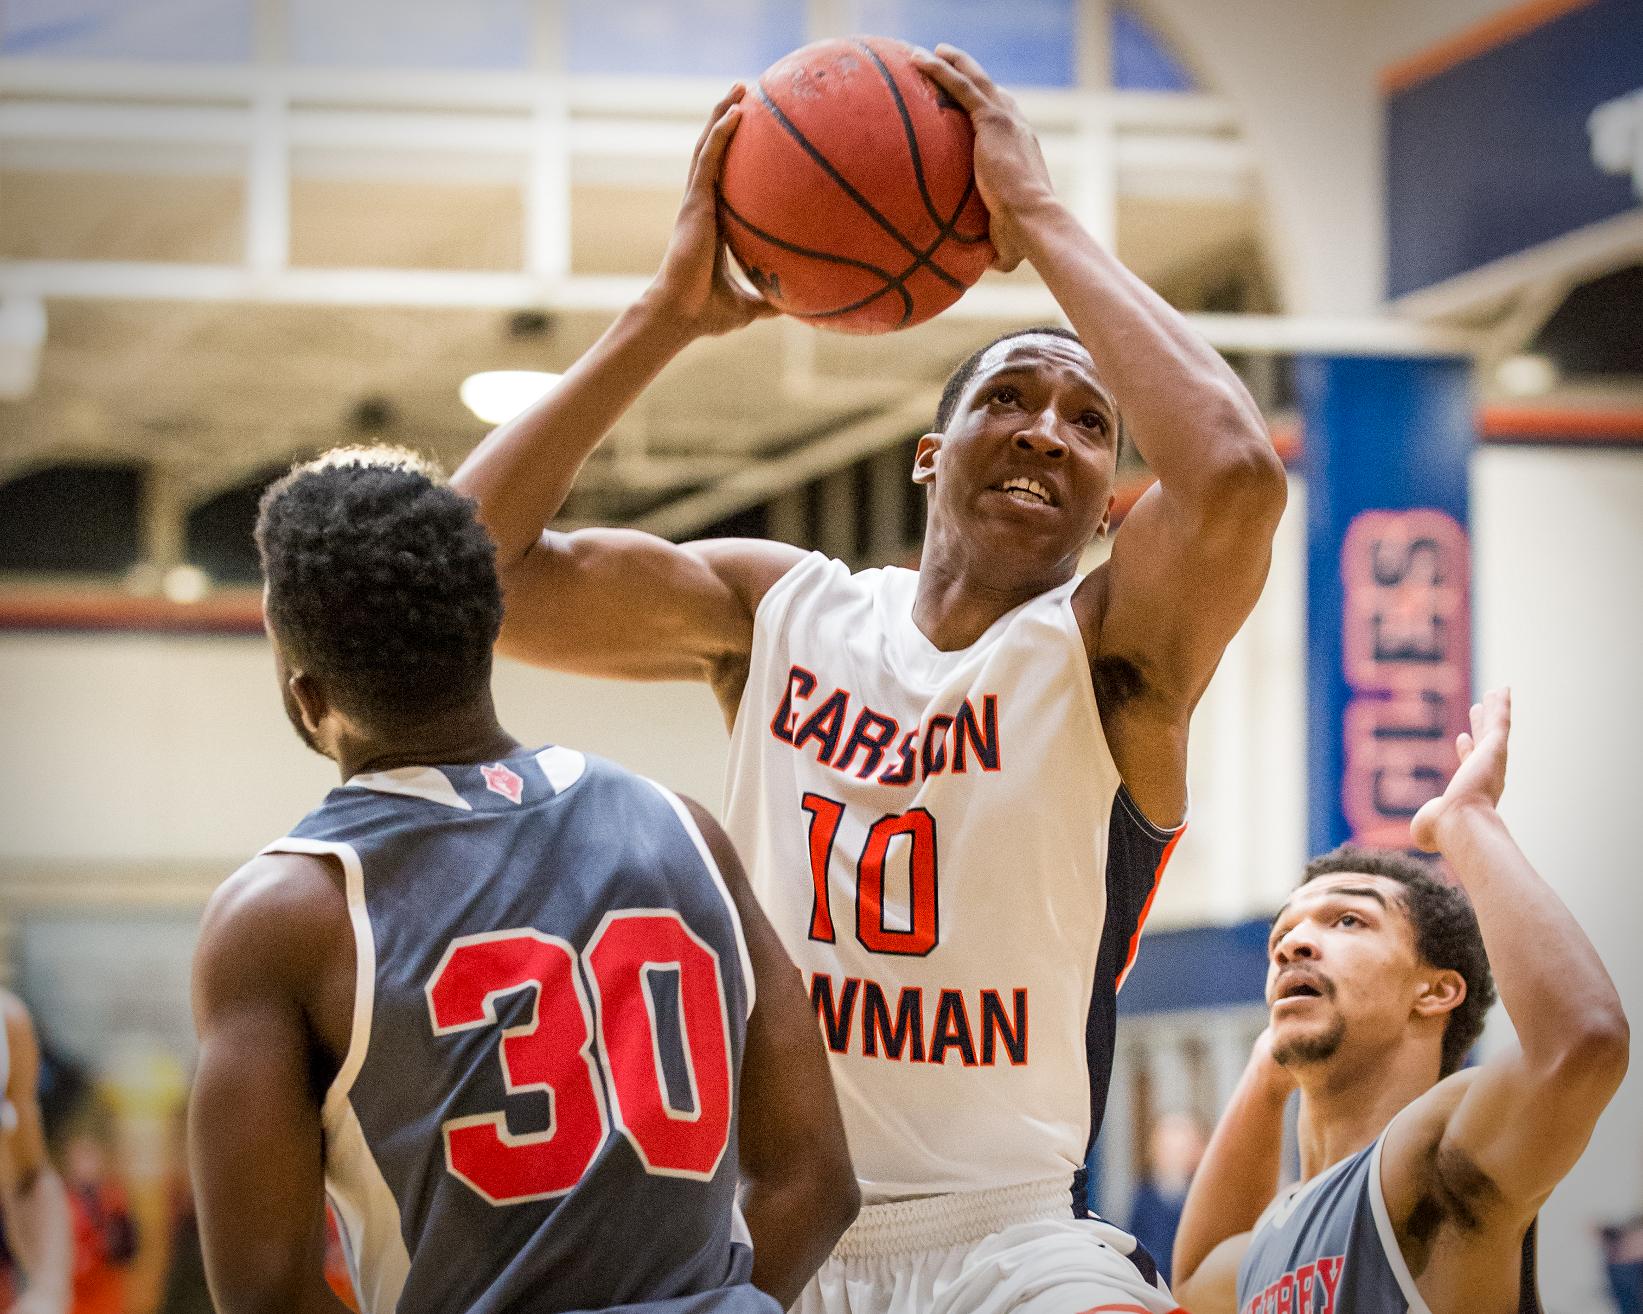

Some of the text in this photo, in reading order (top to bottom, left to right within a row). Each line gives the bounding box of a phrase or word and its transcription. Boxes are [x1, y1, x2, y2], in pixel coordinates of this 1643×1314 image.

[770, 664, 1001, 786] CARSON
[1372, 537, 1446, 864] GLES
[801, 791, 939, 958] 10
[424, 908, 734, 1207] 30
